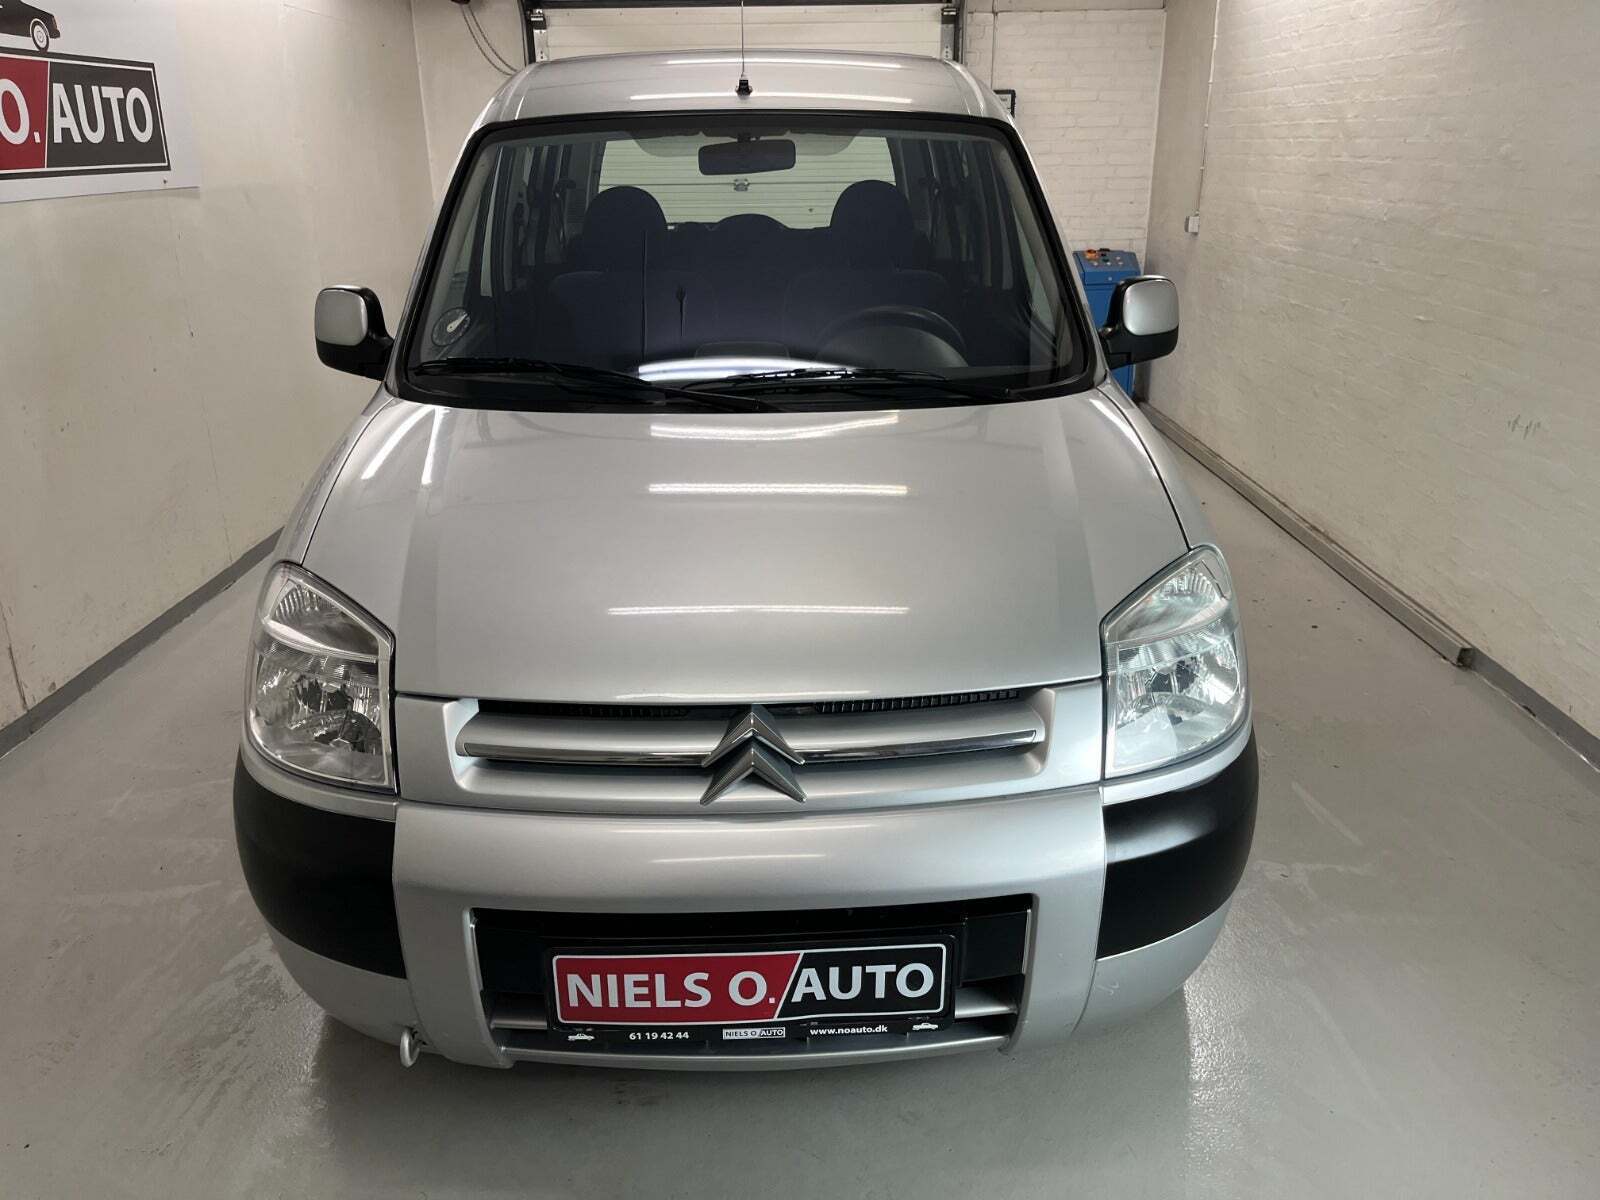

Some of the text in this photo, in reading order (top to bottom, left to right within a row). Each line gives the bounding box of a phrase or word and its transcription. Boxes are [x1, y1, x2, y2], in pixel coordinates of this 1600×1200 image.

[52, 82, 153, 144] AUTO
[566, 962, 934, 1008] NIELS O. AUTO
[629, 1031, 690, 1041] 61 19 42 44
[725, 1030, 749, 1038] NIELS
[809, 1024, 888, 1036] www.noauto.dk
